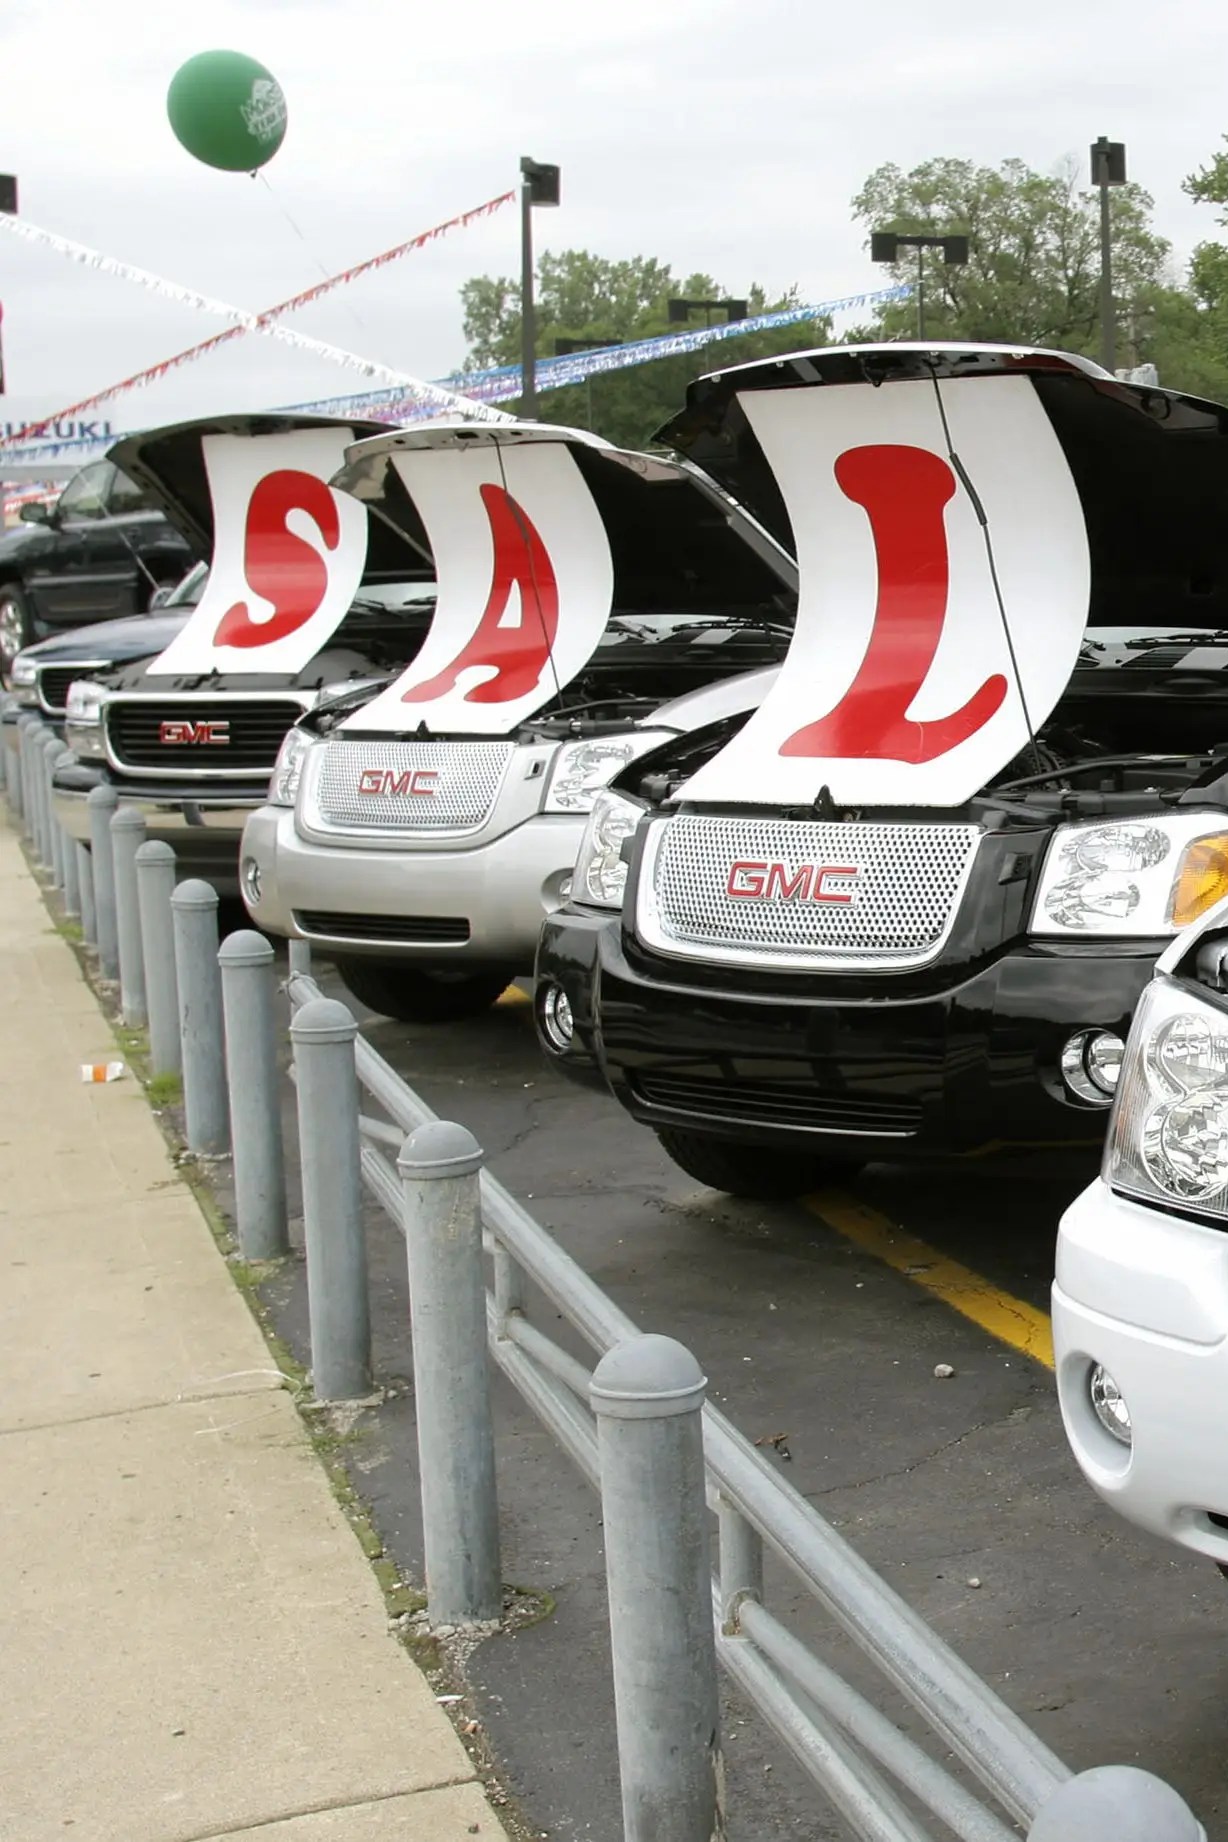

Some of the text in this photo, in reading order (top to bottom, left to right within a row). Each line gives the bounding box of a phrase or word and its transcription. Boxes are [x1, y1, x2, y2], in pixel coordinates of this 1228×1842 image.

[0, 421, 112, 438] UZUKI
[213, 469, 340, 649] S
[401, 483, 559, 704] A
[778, 444, 1008, 765] L
[160, 721, 230, 744] GMC
[359, 769, 440, 796] GMC
[726, 860, 861, 907] GMC
